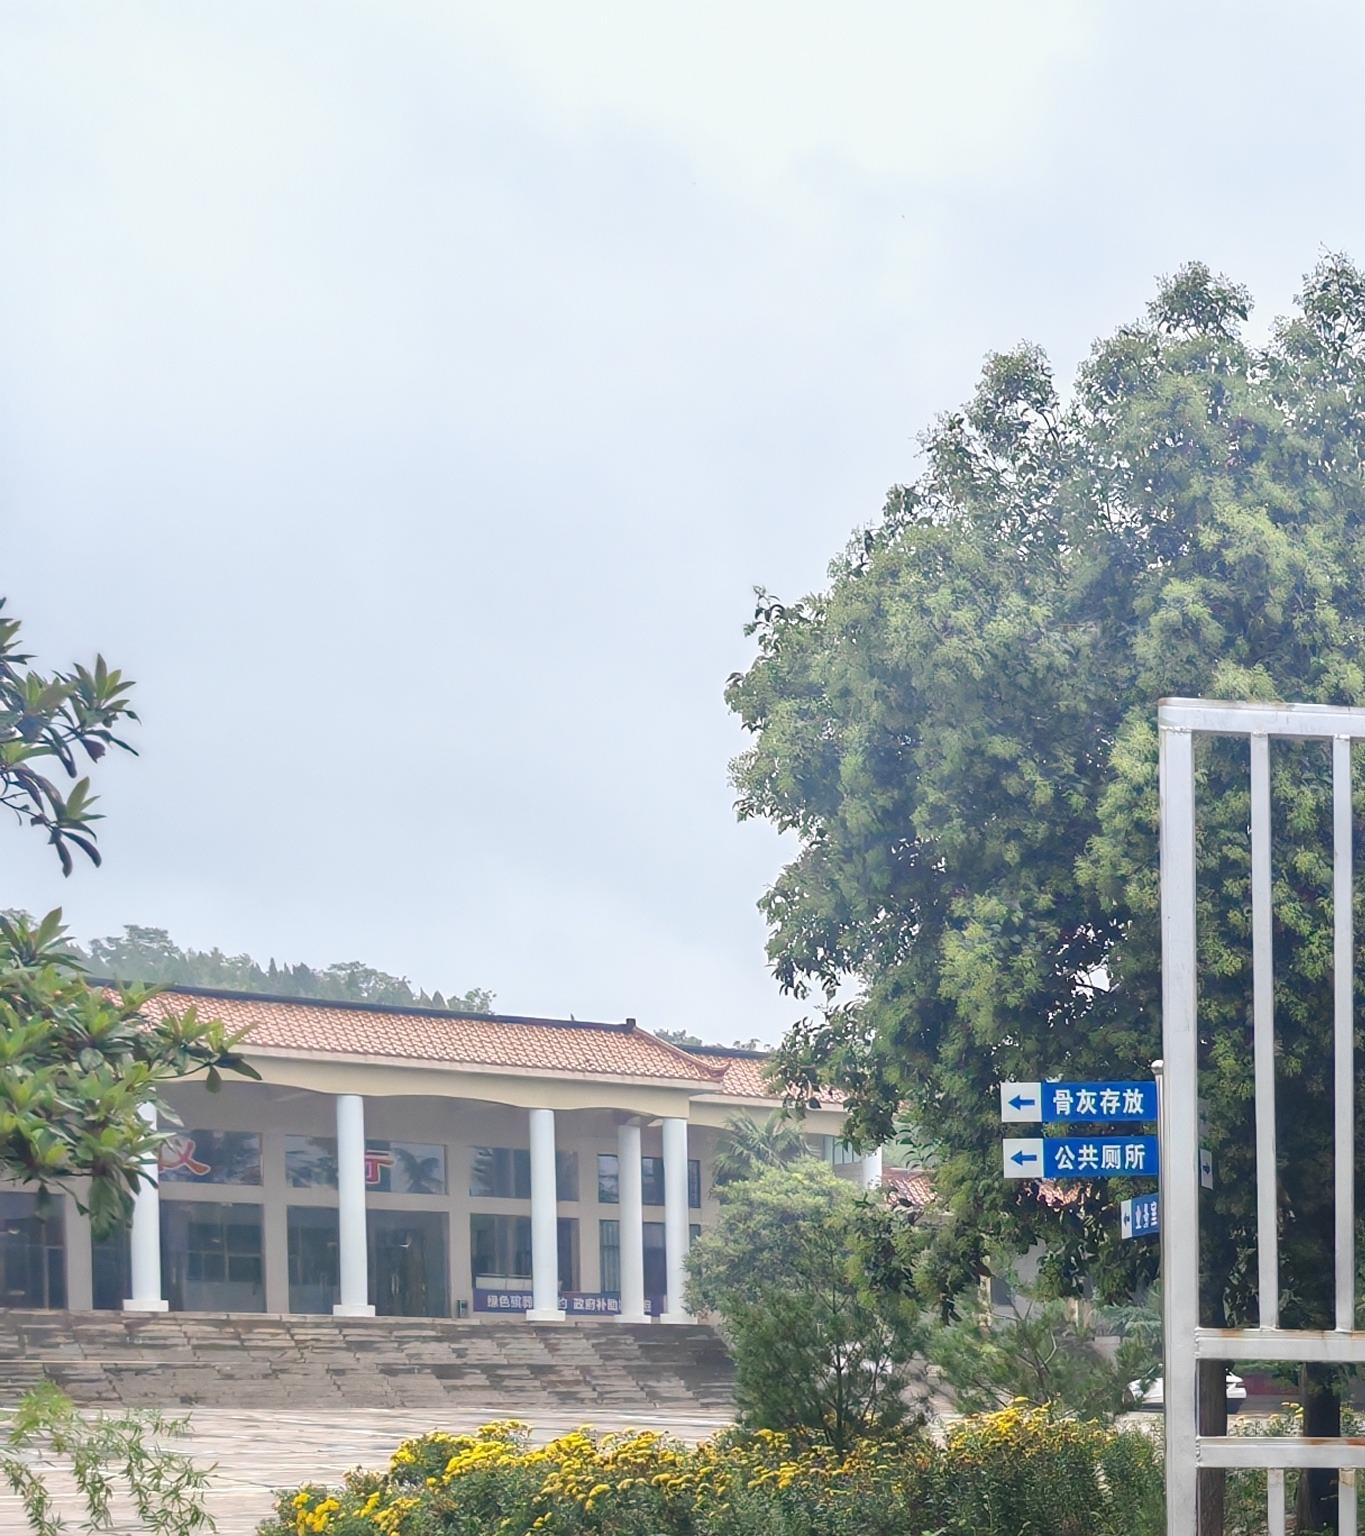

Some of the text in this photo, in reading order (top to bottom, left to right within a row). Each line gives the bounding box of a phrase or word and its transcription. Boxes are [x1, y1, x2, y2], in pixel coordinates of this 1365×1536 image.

[1053, 1089, 1144, 1115] 骨灰存放
[1055, 1144, 1146, 1170] 公共厕所
